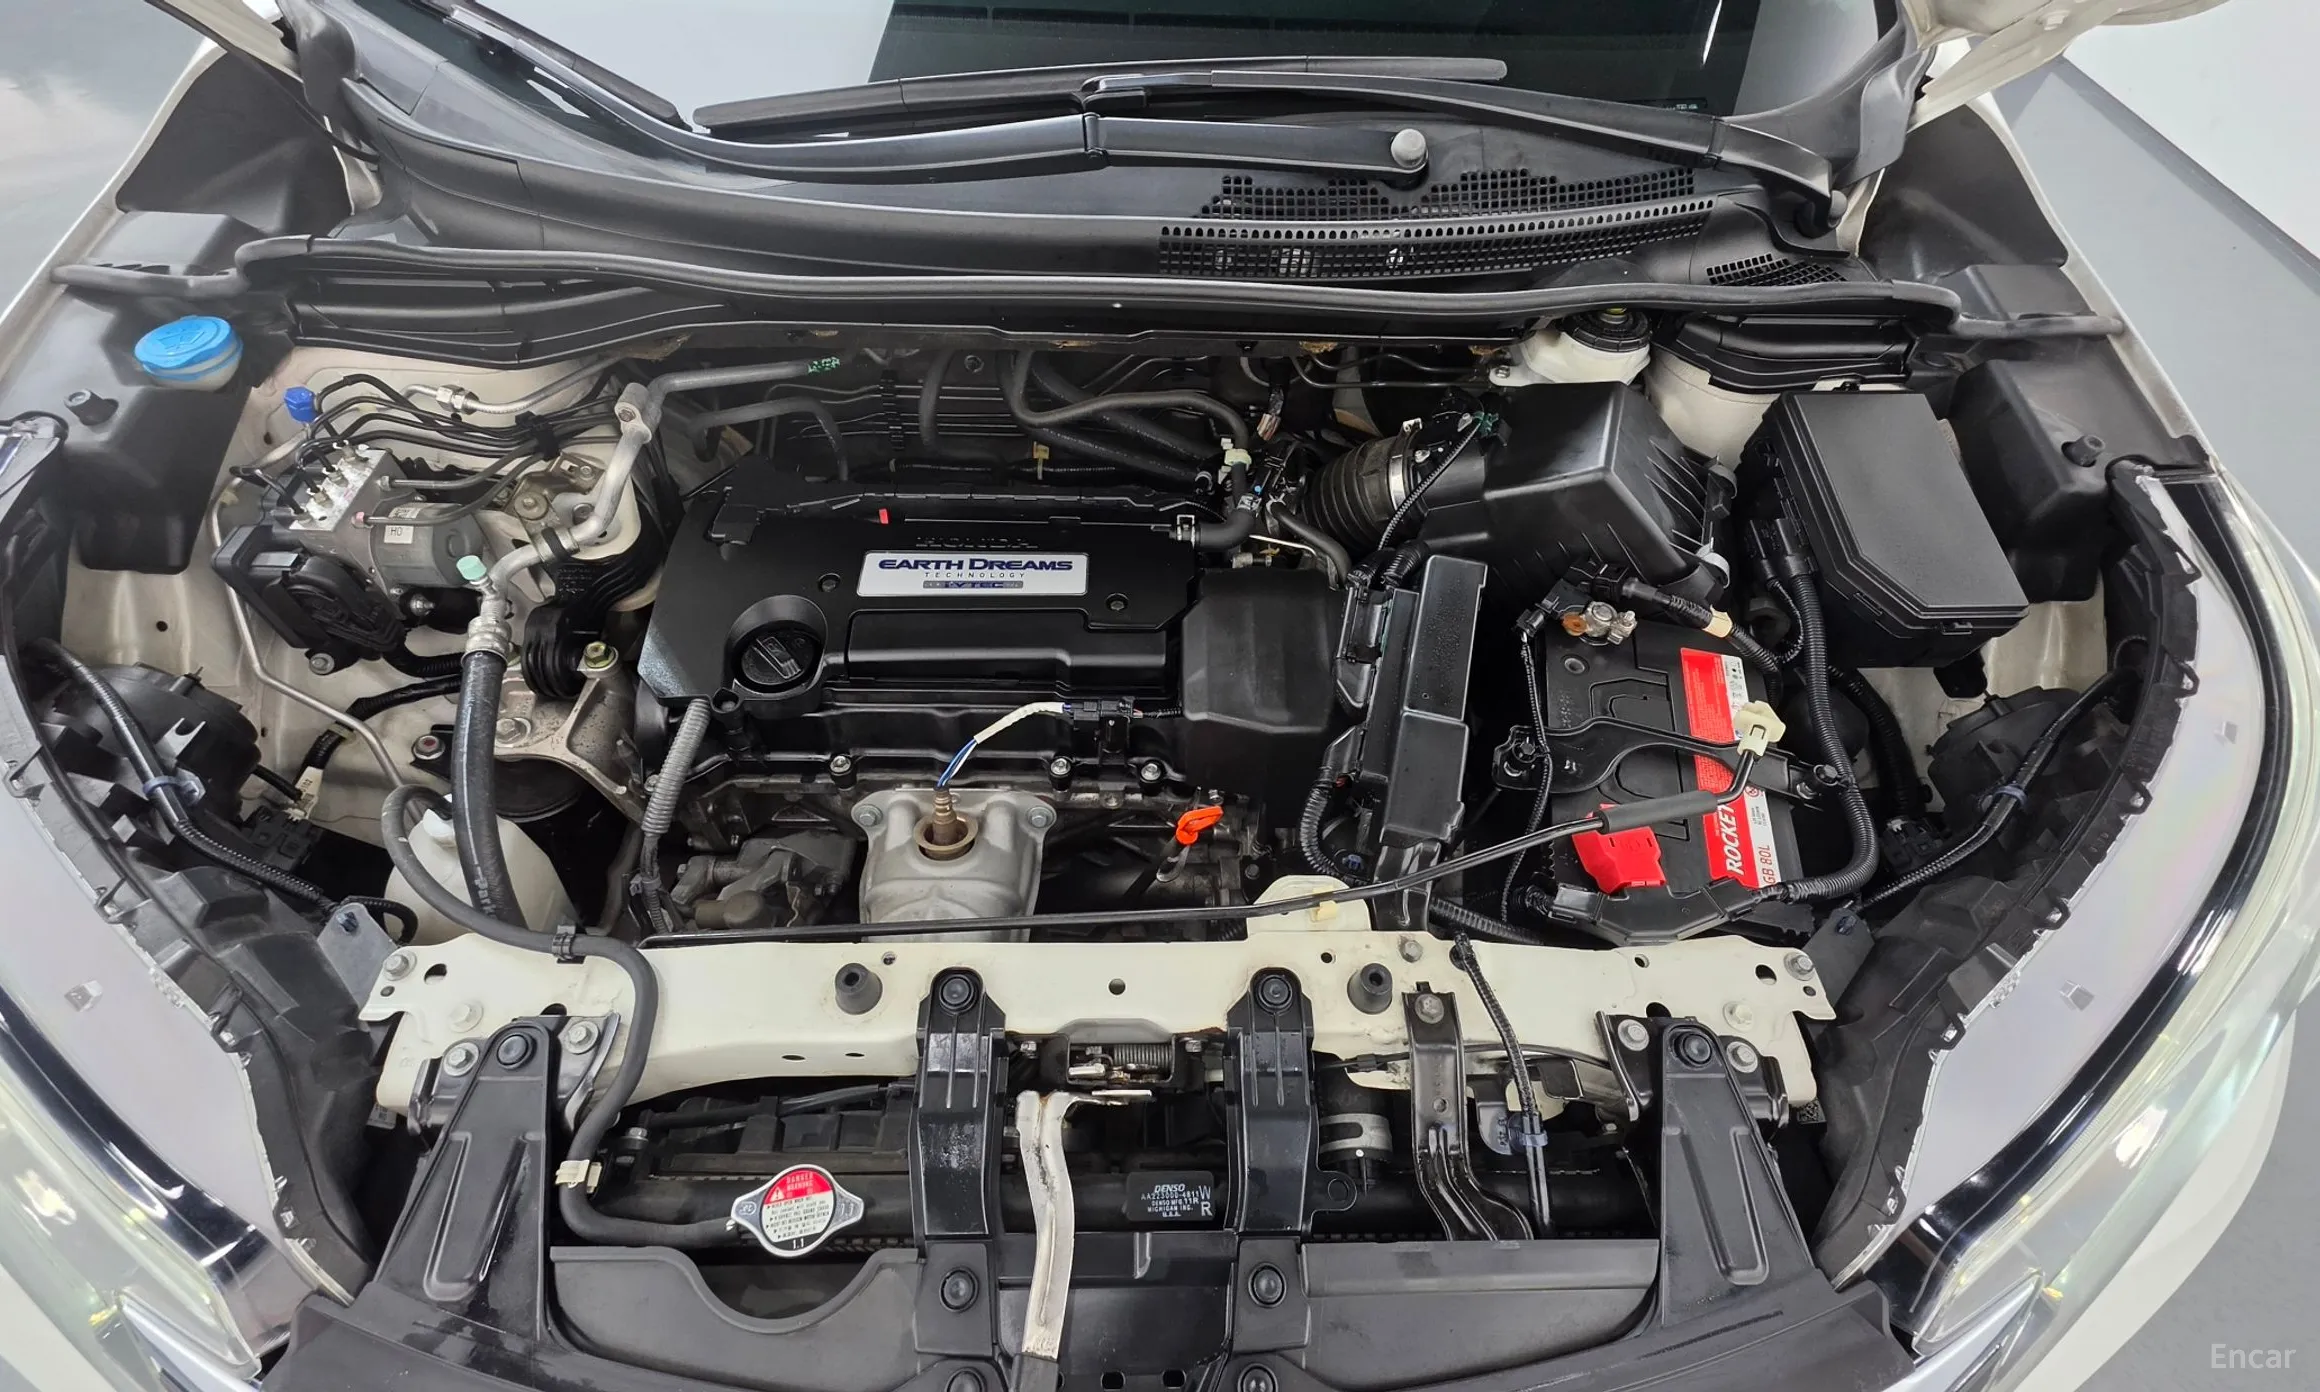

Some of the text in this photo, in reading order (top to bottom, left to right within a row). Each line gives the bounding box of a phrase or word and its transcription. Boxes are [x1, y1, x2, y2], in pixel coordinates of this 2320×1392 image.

[878, 558, 1073, 571] EARTH DREAMS
[1758, 845, 1773, 866] 80L
[1761, 867, 1776, 884] GB
[1154, 1183, 1186, 1193] DENSO
[1198, 1185, 1211, 1200] W
[1201, 1201, 1213, 1216] R
[793, 1237, 804, 1249] 1.1
